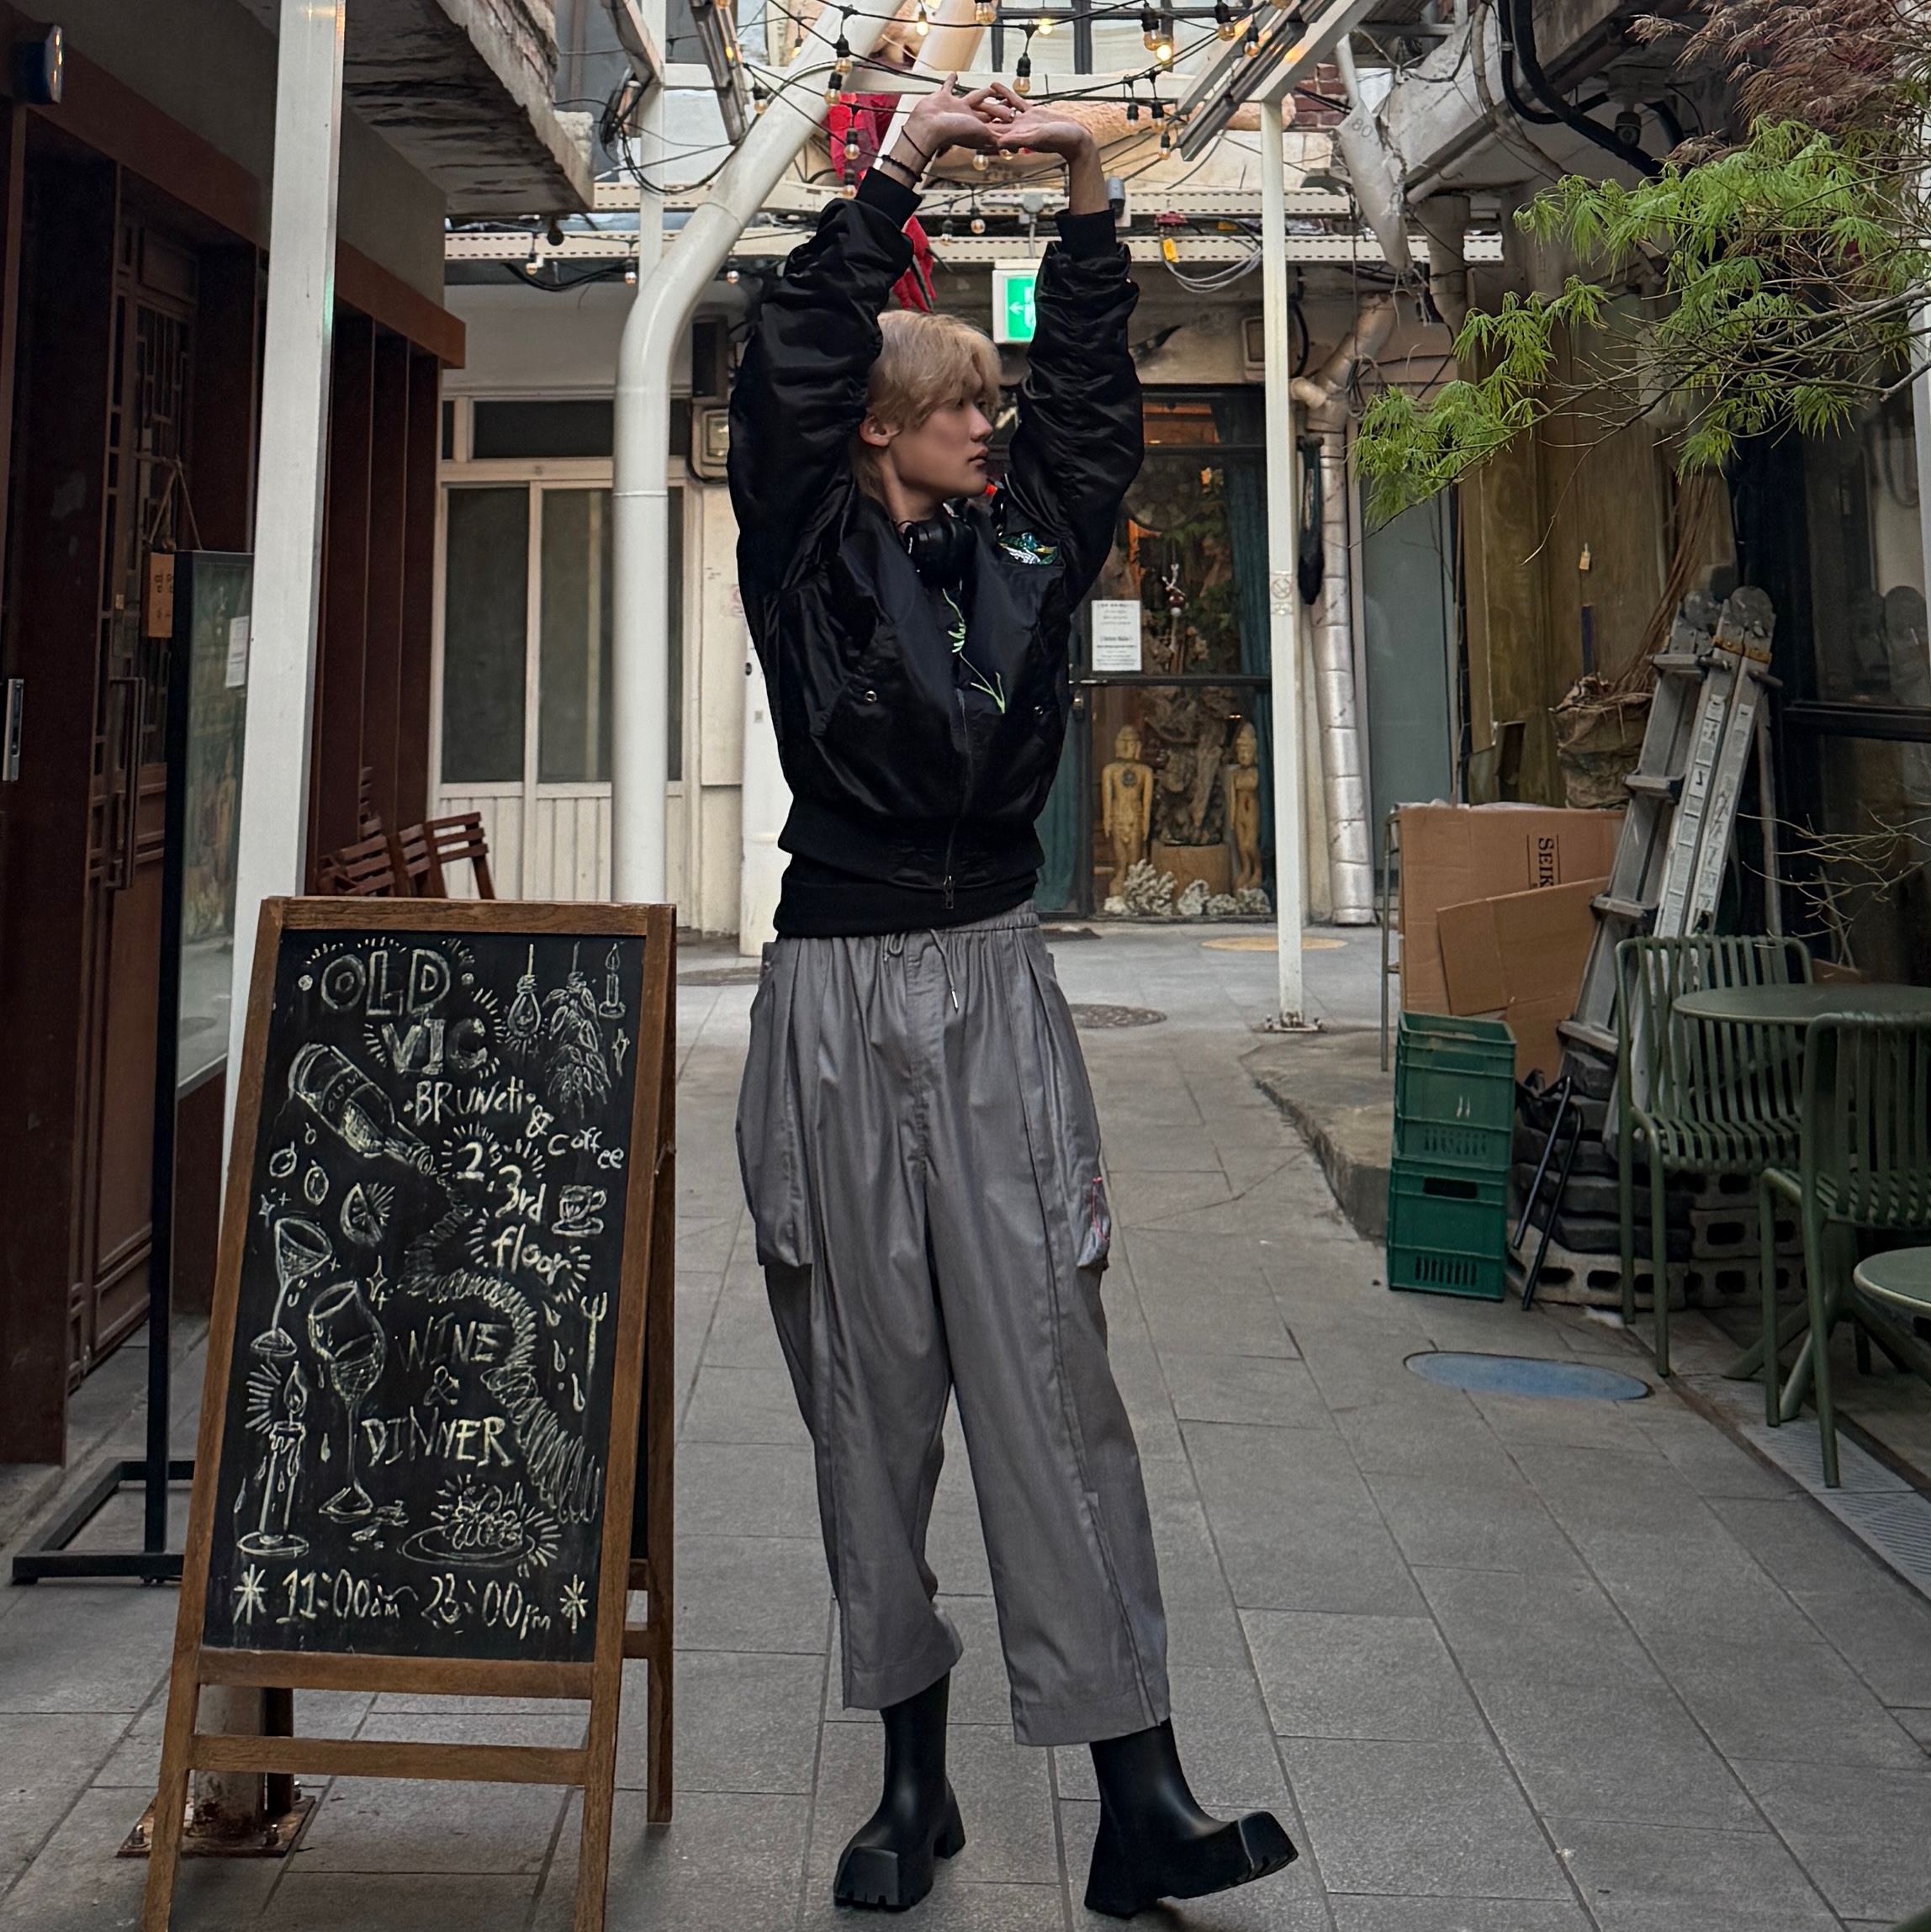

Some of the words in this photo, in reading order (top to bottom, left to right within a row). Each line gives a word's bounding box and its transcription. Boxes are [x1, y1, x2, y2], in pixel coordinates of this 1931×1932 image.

[320, 948, 451, 1016] OLD
[381, 1016, 489, 1076] VIC
[526, 1104, 554, 1139] &
[495, 1164, 547, 1225] 3rd
[490, 1222, 573, 1286] floor
[394, 1311, 508, 1373] WINE
[423, 1364, 461, 1407] &
[360, 1405, 515, 1468] DINNER
